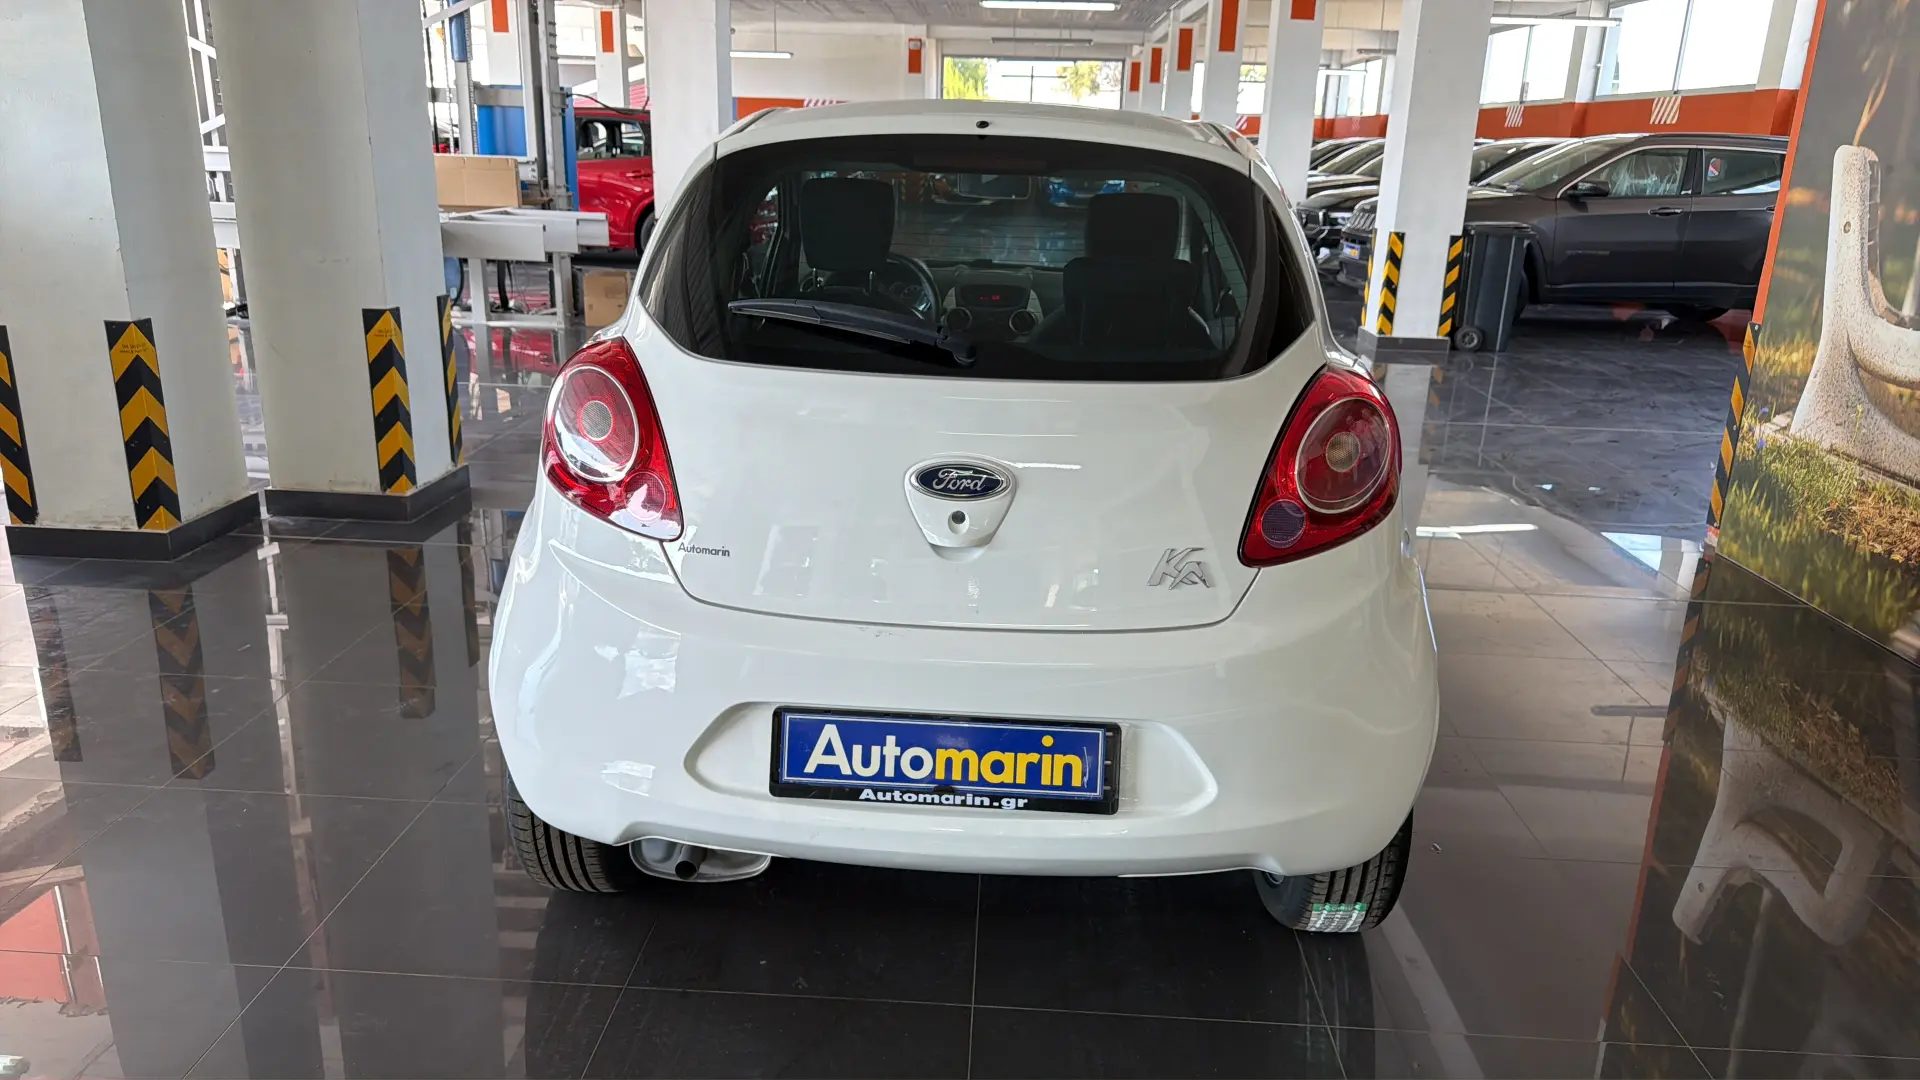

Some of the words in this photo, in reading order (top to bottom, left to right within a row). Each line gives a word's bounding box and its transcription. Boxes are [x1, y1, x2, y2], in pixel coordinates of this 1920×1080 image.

[932, 468, 985, 491] Ford
[678, 541, 730, 557] Automarin
[804, 723, 1083, 787] Automarin
[859, 788, 1028, 810] Automarin.gr
